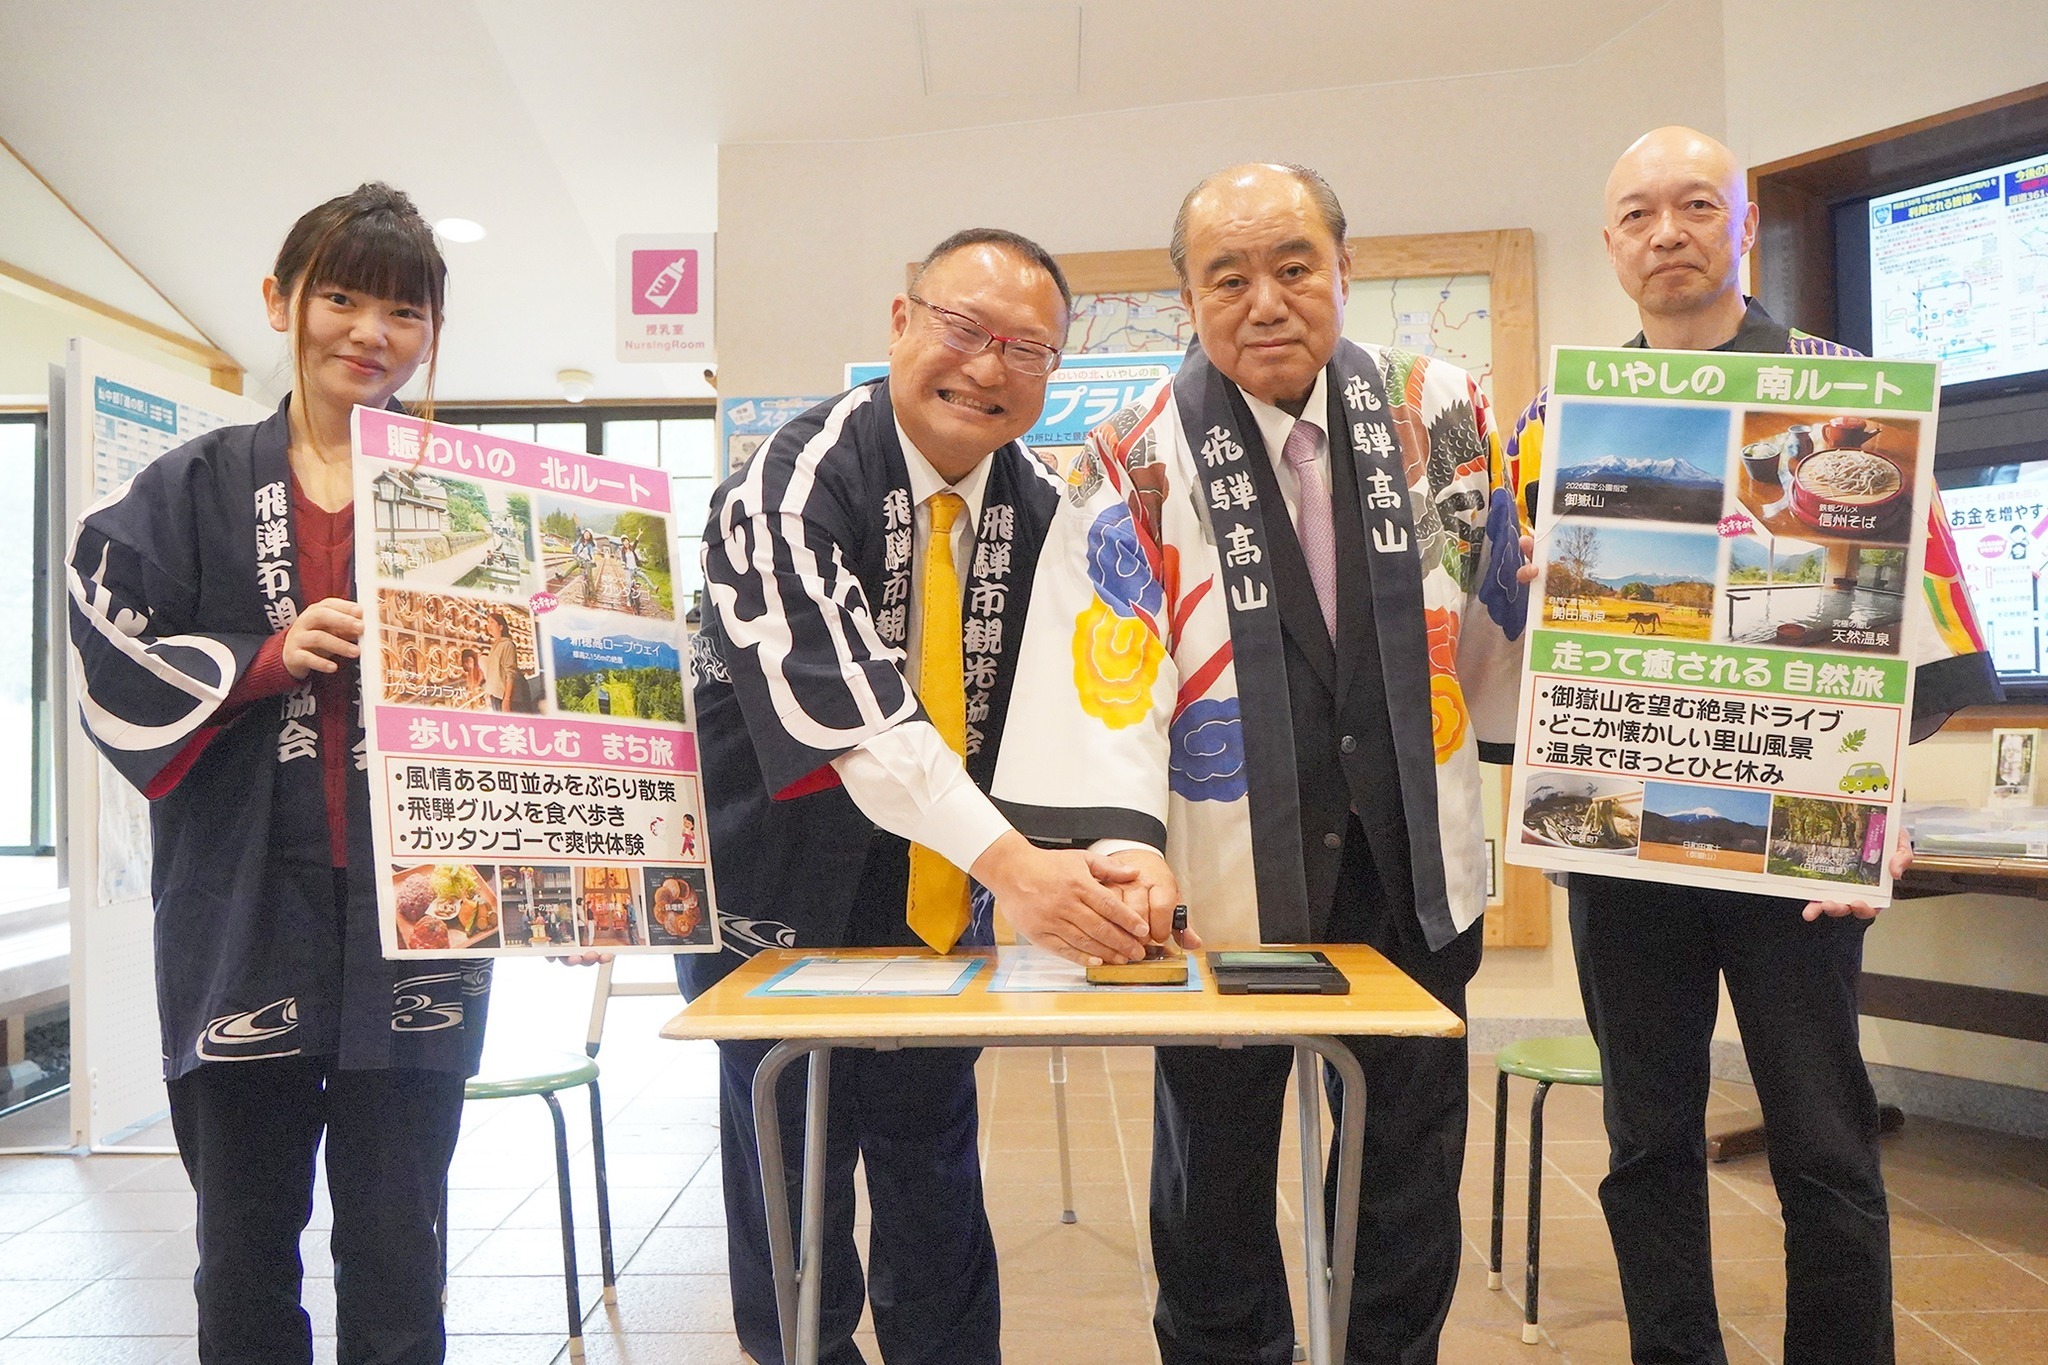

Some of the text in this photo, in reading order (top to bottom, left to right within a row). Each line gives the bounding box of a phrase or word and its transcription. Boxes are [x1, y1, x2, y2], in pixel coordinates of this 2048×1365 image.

[645, 323, 685, 336] 授乳室
[624, 341, 706, 352] NursingRoom
[1586, 361, 1902, 404] いやしの 南ルート
[386, 424, 651, 503] 賑わいの 北ルート
[1564, 492, 1605, 509] 御嶽山
[1818, 512, 1877, 529] 信州そば
[1951, 503, 2044, 527] お金を増やす
[1718, 518, 1752, 535] おすすめ
[1552, 606, 1606, 623] 開田高原
[1831, 628, 1891, 647] 天然温泉
[1550, 641, 1886, 699] 走って癒される 自然旅
[408, 717, 581, 759] 歩いて楽しむ
[601, 732, 675, 767] まち旅
